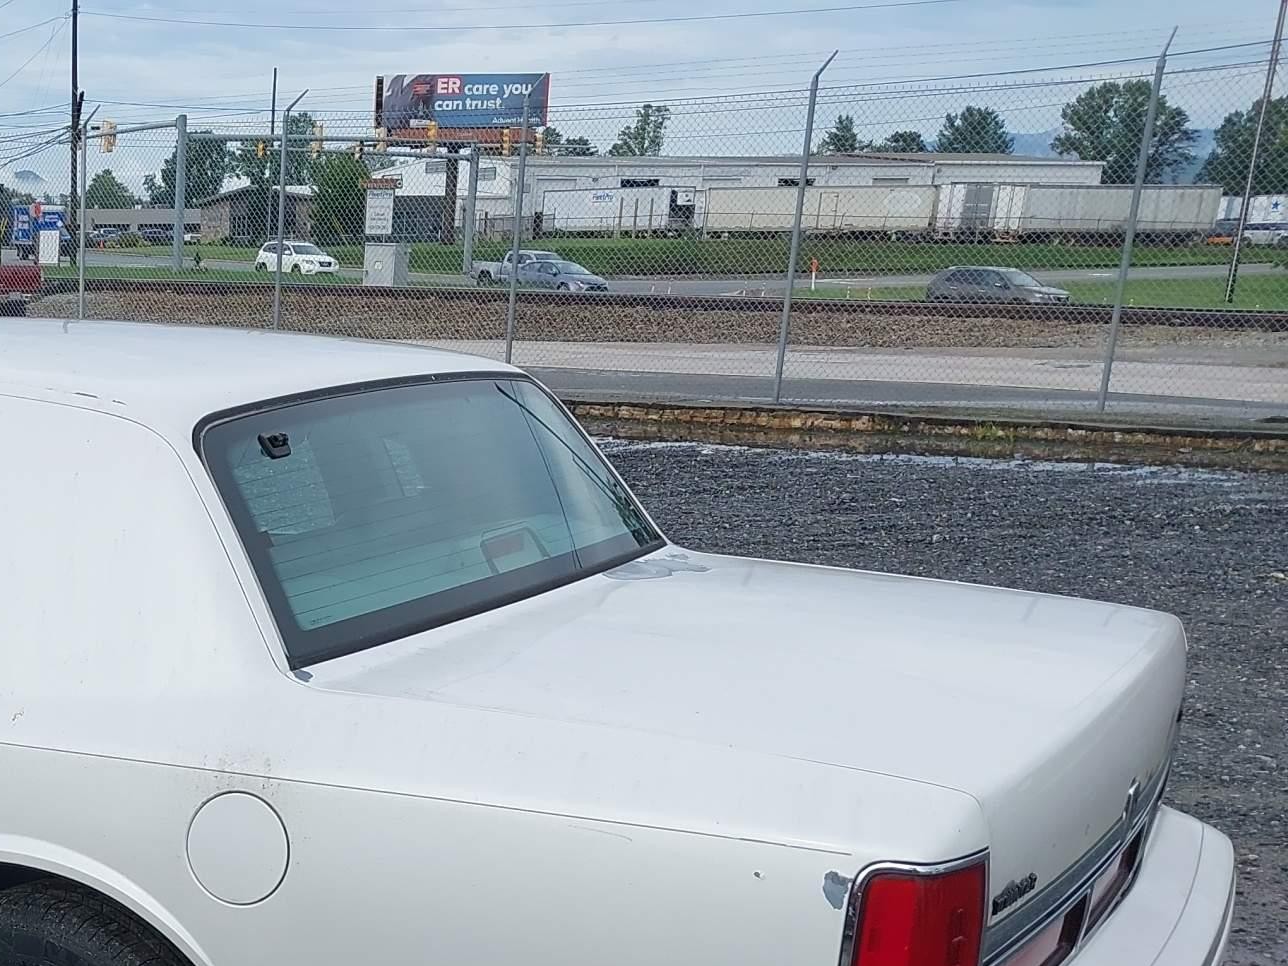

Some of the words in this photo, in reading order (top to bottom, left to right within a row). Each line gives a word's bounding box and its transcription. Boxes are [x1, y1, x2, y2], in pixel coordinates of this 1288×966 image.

[437, 77, 461, 94] ER
[465, 83, 499, 95] care
[503, 83, 533, 98] you
[434, 99, 463, 111] can
